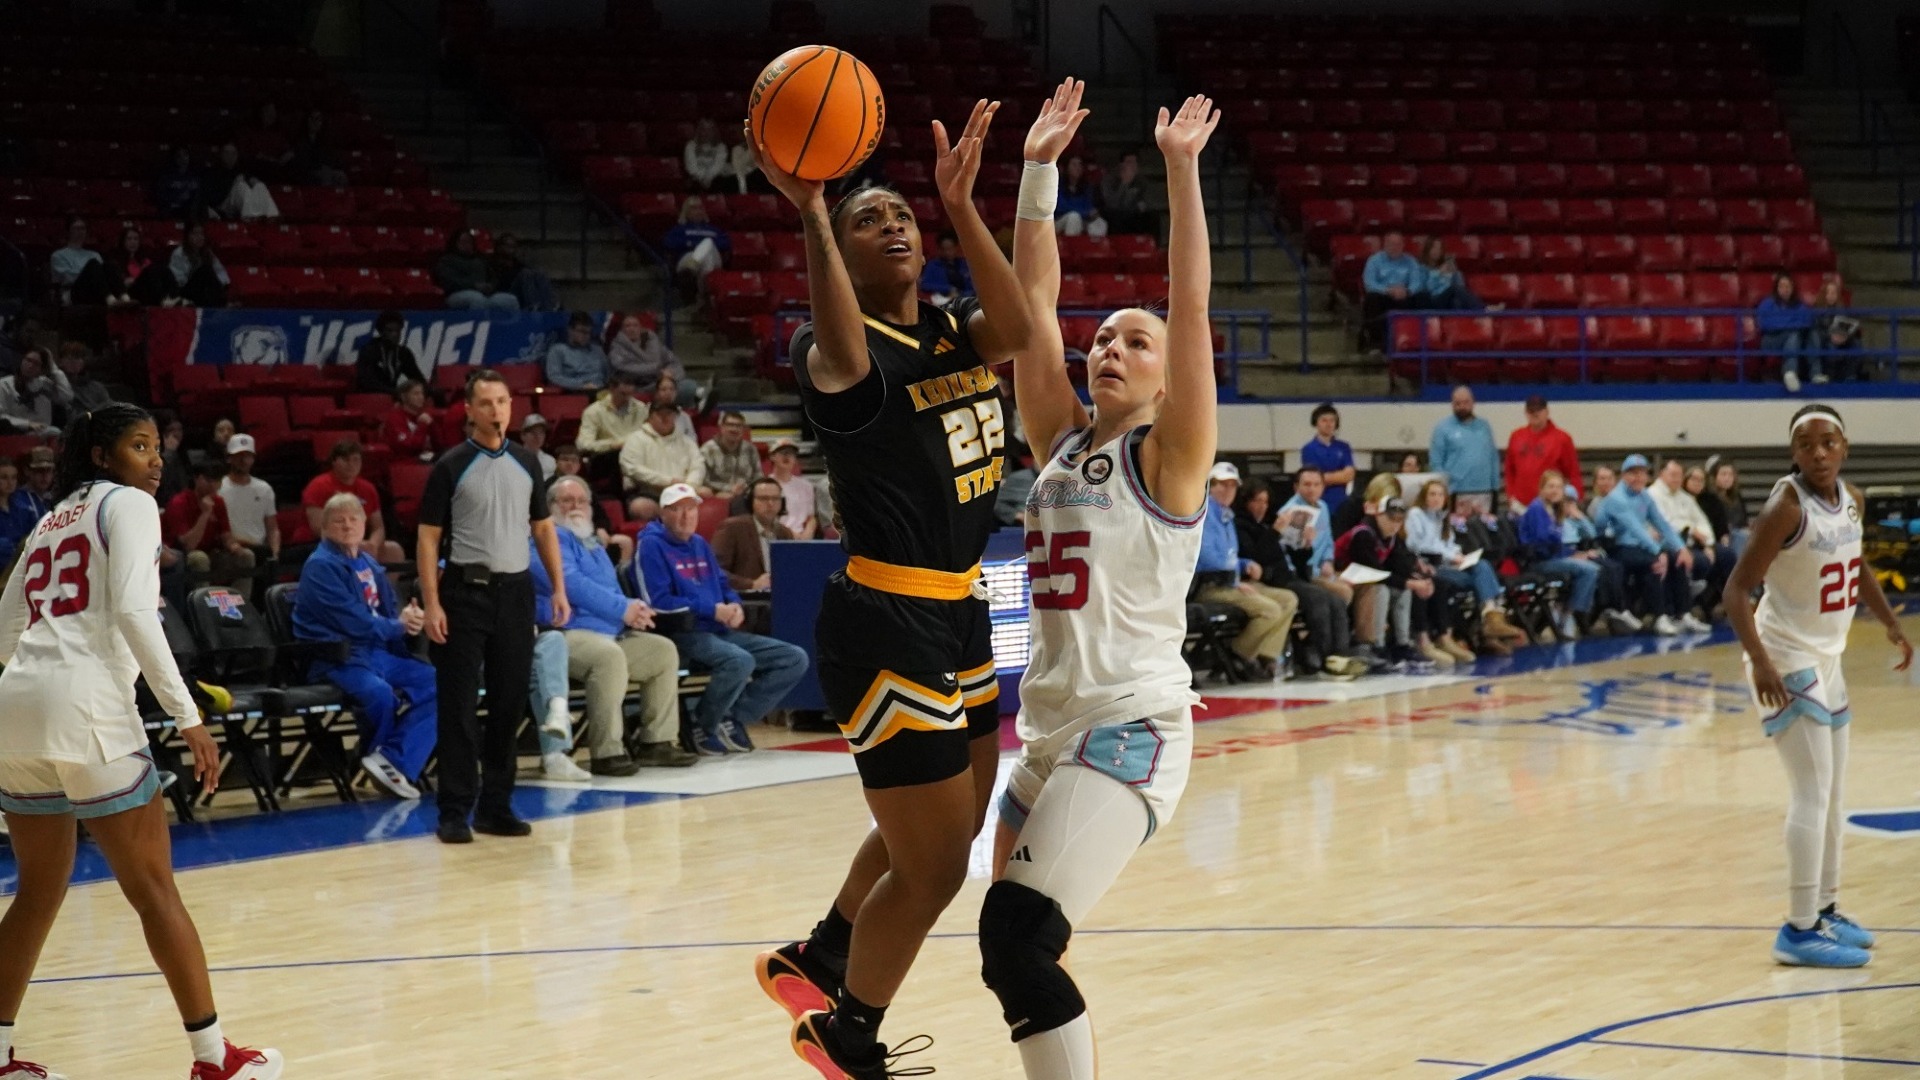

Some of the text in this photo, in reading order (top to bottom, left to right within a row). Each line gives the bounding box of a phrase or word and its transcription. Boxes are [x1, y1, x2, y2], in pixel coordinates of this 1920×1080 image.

[905, 364, 998, 412] KENNESA
[940, 397, 1005, 468] 22
[954, 456, 1005, 504] STAE
[38, 503, 92, 536] BRADLEY
[24, 533, 91, 630] 23
[1025, 531, 1091, 610] 25
[1820, 557, 1862, 614] 22
